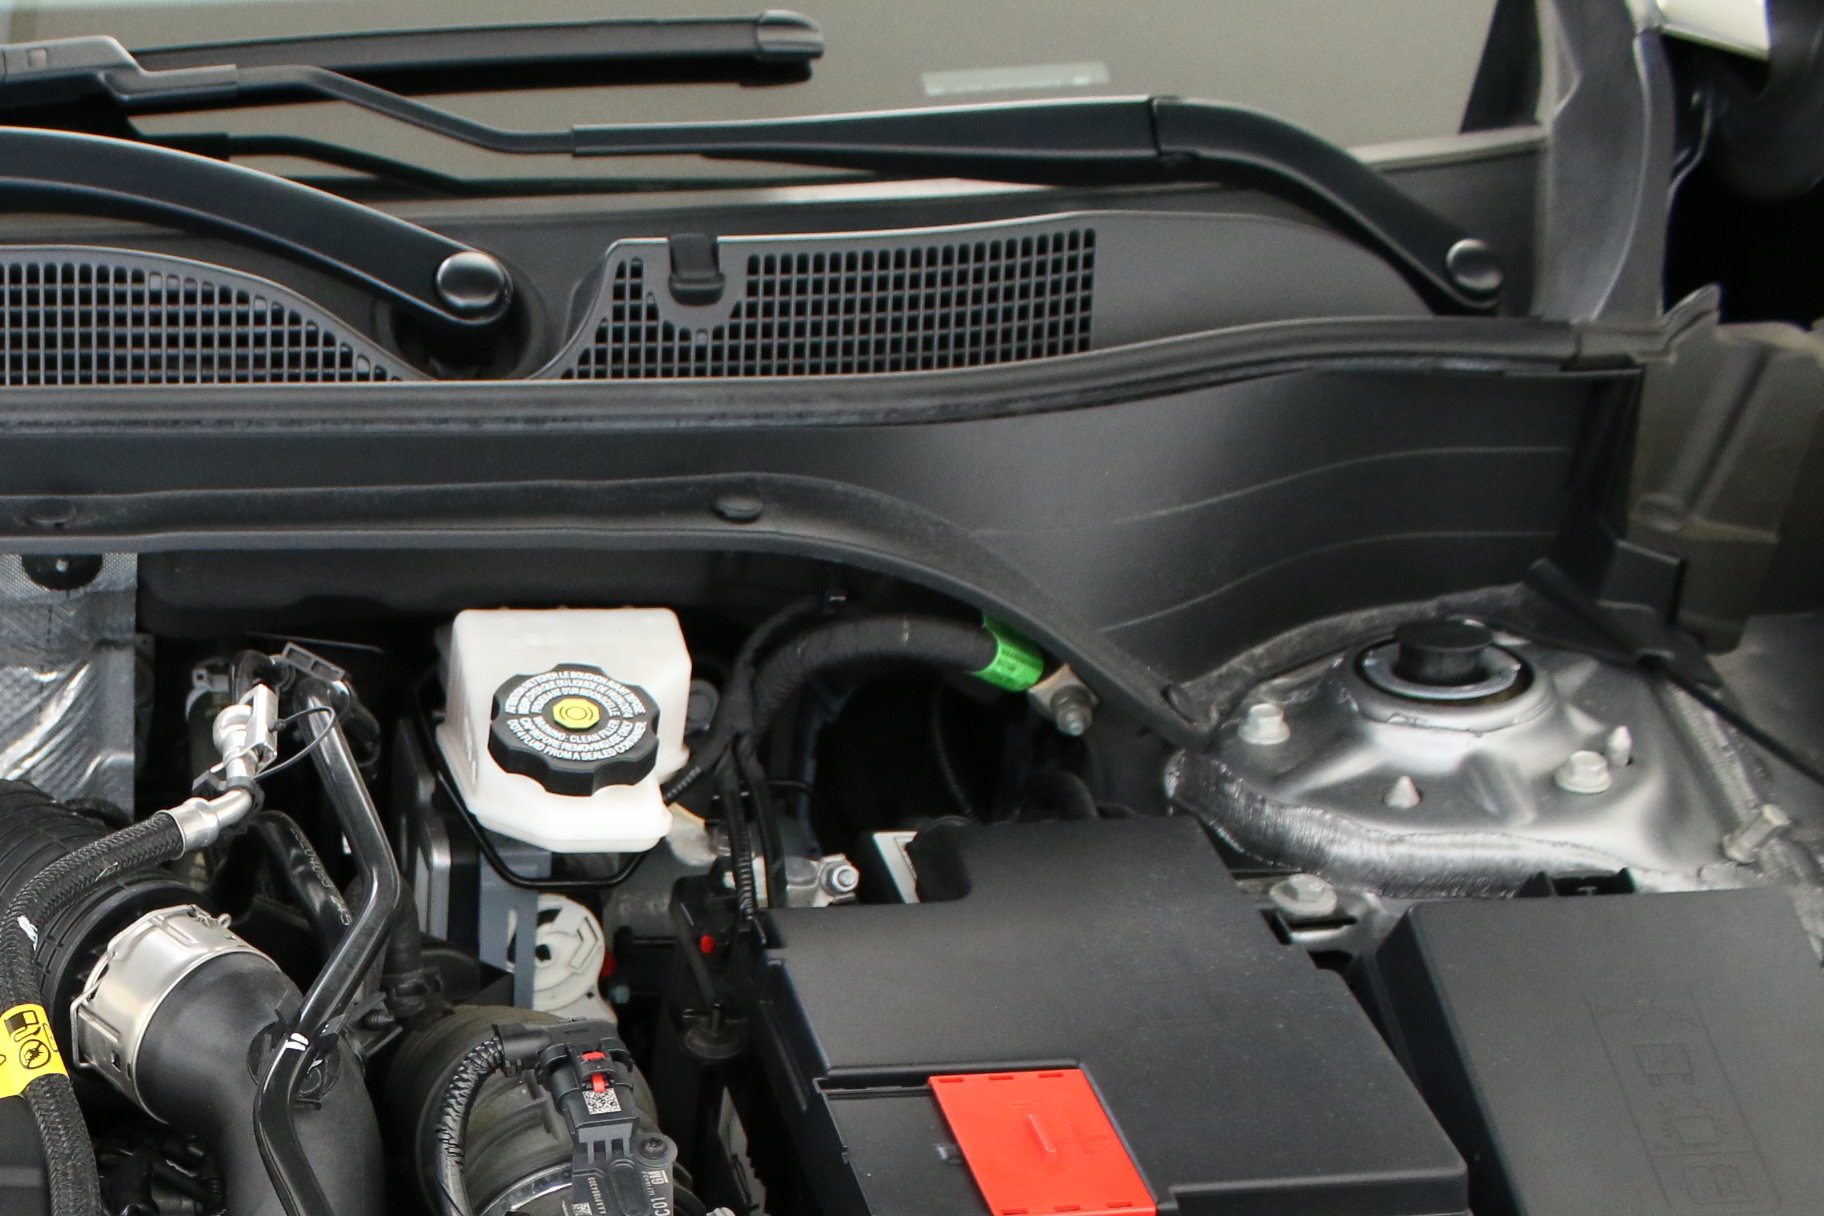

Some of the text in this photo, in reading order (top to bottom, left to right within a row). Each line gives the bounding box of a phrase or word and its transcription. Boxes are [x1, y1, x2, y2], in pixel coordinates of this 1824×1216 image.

[558, 670, 568, 678] LE
[518, 717, 537, 732] CAP
[527, 727, 562, 748] BEFORE
[568, 732, 601, 742] CLEAN
[518, 733, 546, 752] FLUID
[542, 745, 571, 759] FROM
[572, 751, 580, 760] A
[580, 746, 618, 760] SEALED
[649, 1170, 669, 1187] GM
